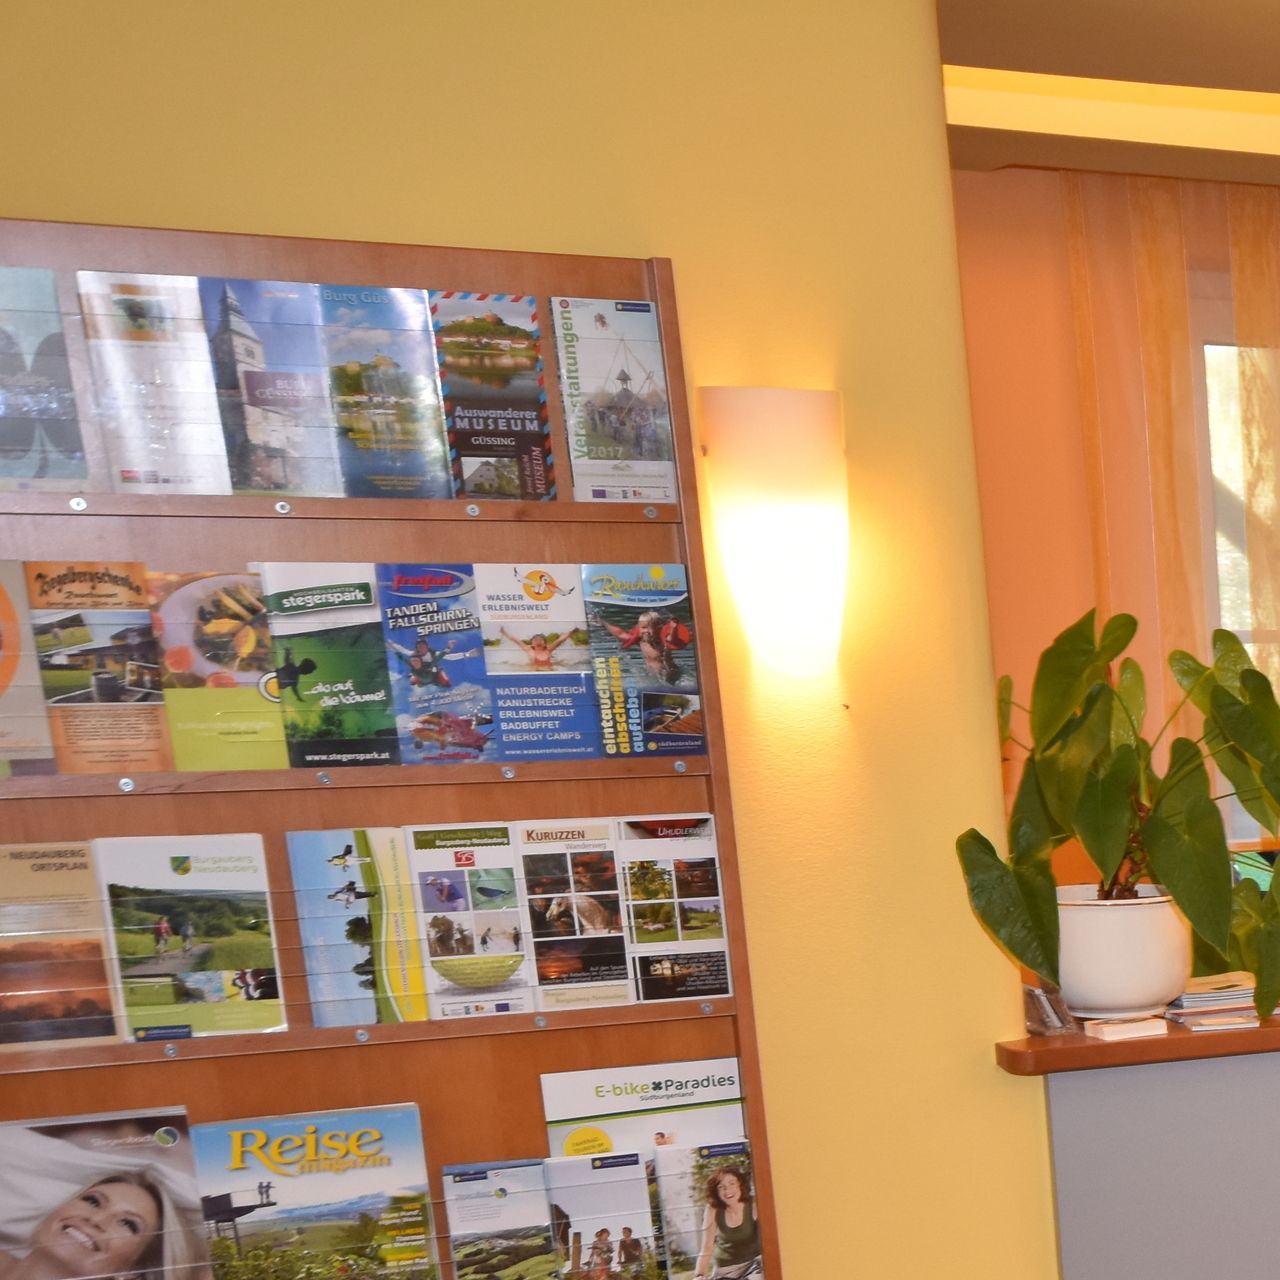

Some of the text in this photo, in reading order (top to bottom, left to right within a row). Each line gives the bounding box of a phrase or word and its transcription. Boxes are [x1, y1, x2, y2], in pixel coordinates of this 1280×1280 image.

[559, 308, 589, 460] Veranstaltungen
[454, 405, 537, 419] Auswanderer
[454, 417, 539, 431] MUSEUM
[471, 435, 516, 446] GÜSSING
[589, 445, 623, 459] 2017
[531, 446, 547, 494] MUSEUM
[282, 588, 367, 608] stegerspark
[486, 594, 524, 602] WASSER
[385, 602, 438, 618] TANDEM
[482, 603, 550, 611] ERLEBNISWELT
[388, 608, 472, 629] FALLSCHIRM-
[417, 618, 480, 637] SPRINGEN
[496, 686, 587, 696] NATURBADETEICH
[498, 697, 574, 708] KANUSTRECKE
[593, 656, 617, 754] eintauchen
[499, 708, 576, 719] ERLEBNISWELT
[501, 720, 561, 730] BADBUFFET
[503, 731, 581, 742] ENERGY CAMPS
[305, 751, 391, 762] www.stegerspark.at
[526, 829, 585, 842] KURUZZEN
[10, 848, 86, 860] NEUDAUBERG
[30, 861, 89, 872] ORTSPLAN
[594, 1073, 736, 1099] E-bike Paradies
[639, 1091, 695, 1102] Südburgenland
[226, 1124, 383, 1177] Reise
